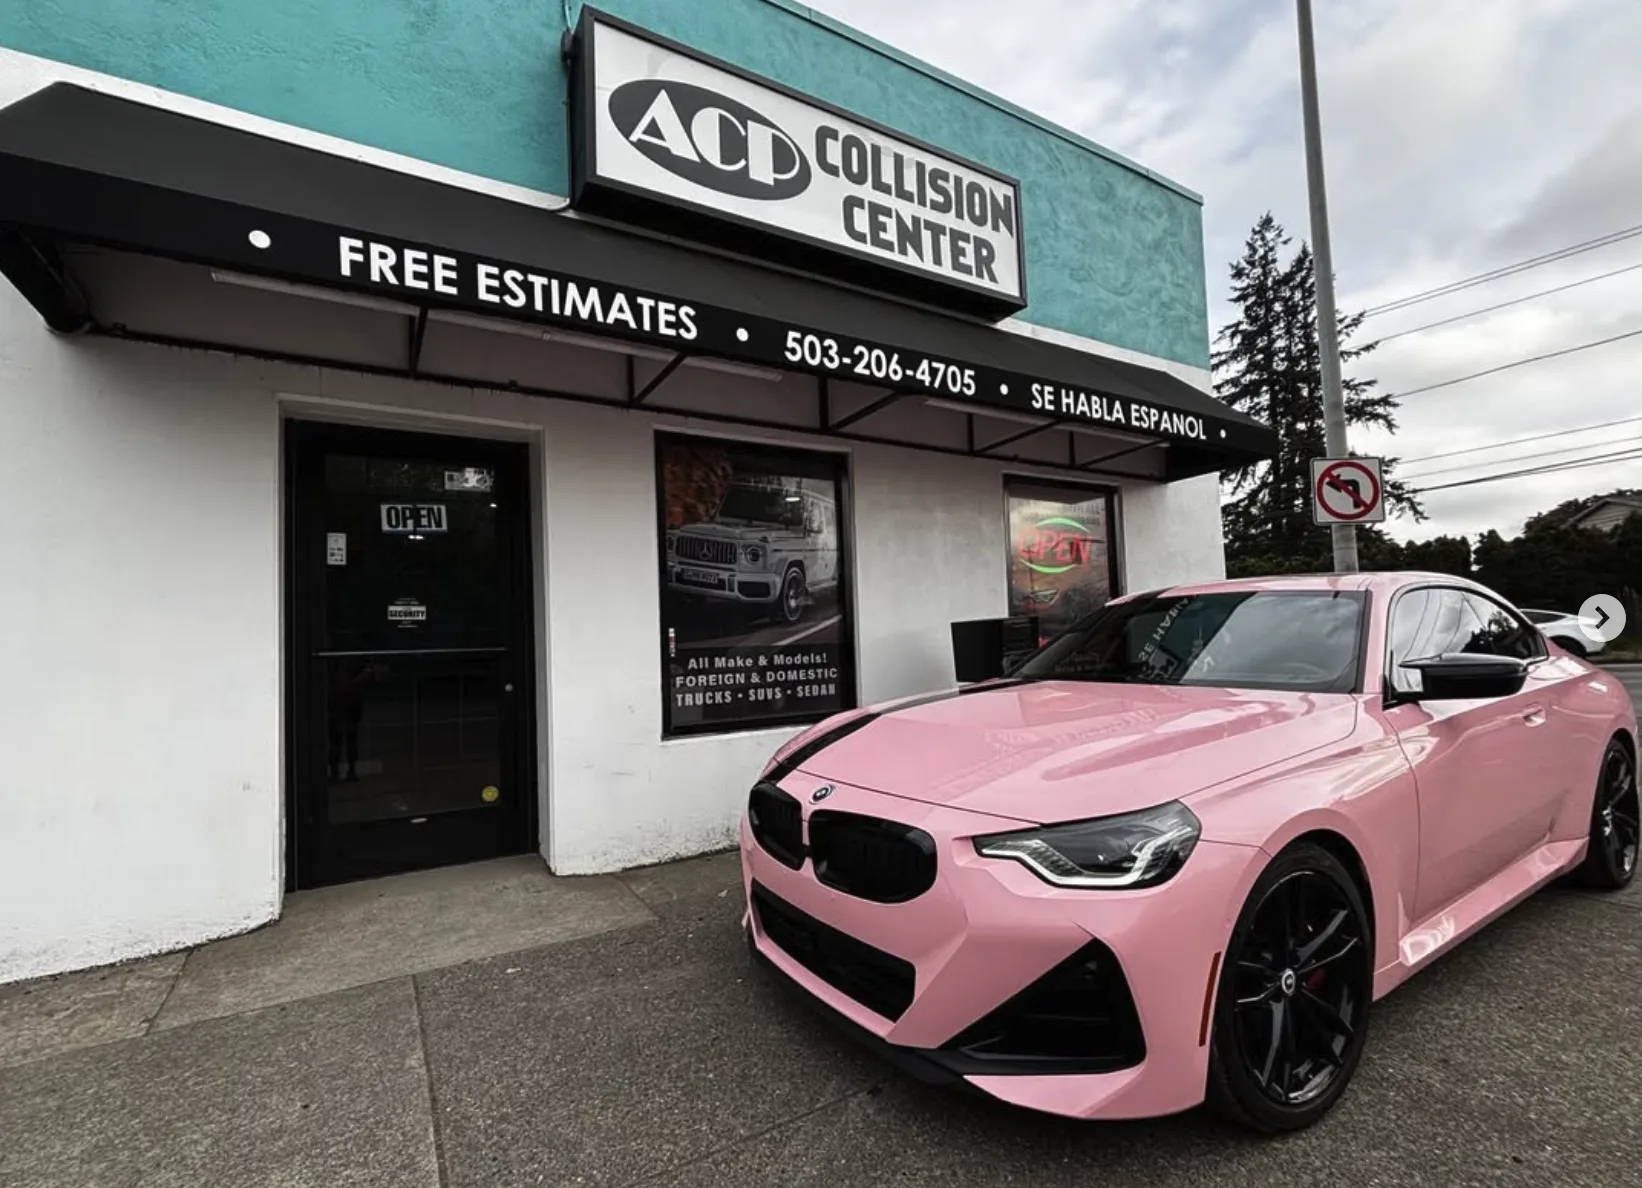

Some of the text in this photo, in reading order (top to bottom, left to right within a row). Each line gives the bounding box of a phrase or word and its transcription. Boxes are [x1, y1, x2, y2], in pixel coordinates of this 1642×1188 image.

[629, 89, 800, 186] ACP
[814, 125, 1015, 238] COLLISION
[841, 195, 999, 284] CENTER
[338, 236, 1207, 441] FREE ESTIMATES 503-206-4705 SE HABLA ESPANOL
[386, 505, 443, 529] OPEN
[1017, 528, 1093, 566] OPEN
[675, 668, 838, 688] FOREIGN & DOMESTIC
[687, 652, 827, 670] All Make & Models!
[675, 683, 836, 707] TRUCKS SUVS SEDAN
